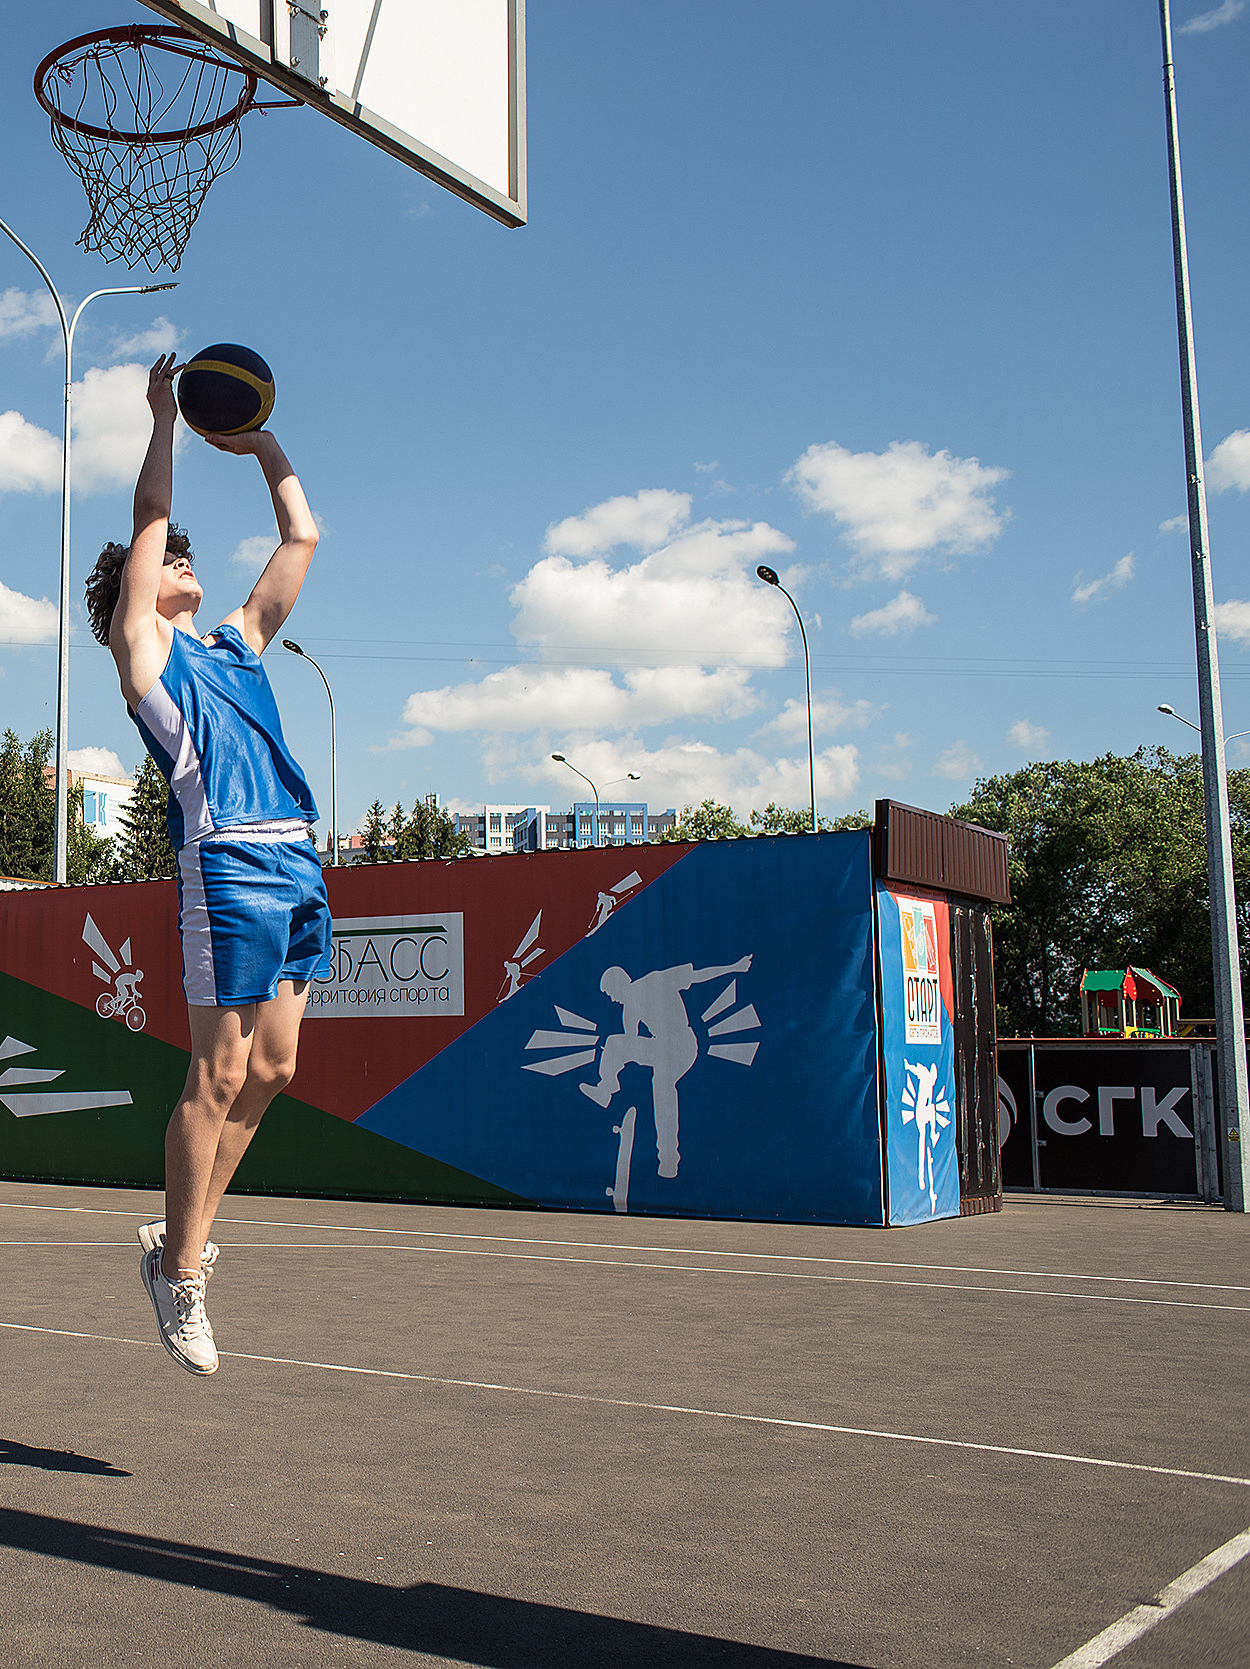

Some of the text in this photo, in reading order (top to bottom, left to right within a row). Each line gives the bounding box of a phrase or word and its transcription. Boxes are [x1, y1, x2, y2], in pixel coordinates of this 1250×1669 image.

[312, 936, 449, 984] ЗБАСС
[390, 986, 450, 1005] спорта
[908, 976, 938, 1022] СТАРТ
[1043, 1085, 1194, 1138] СГК
